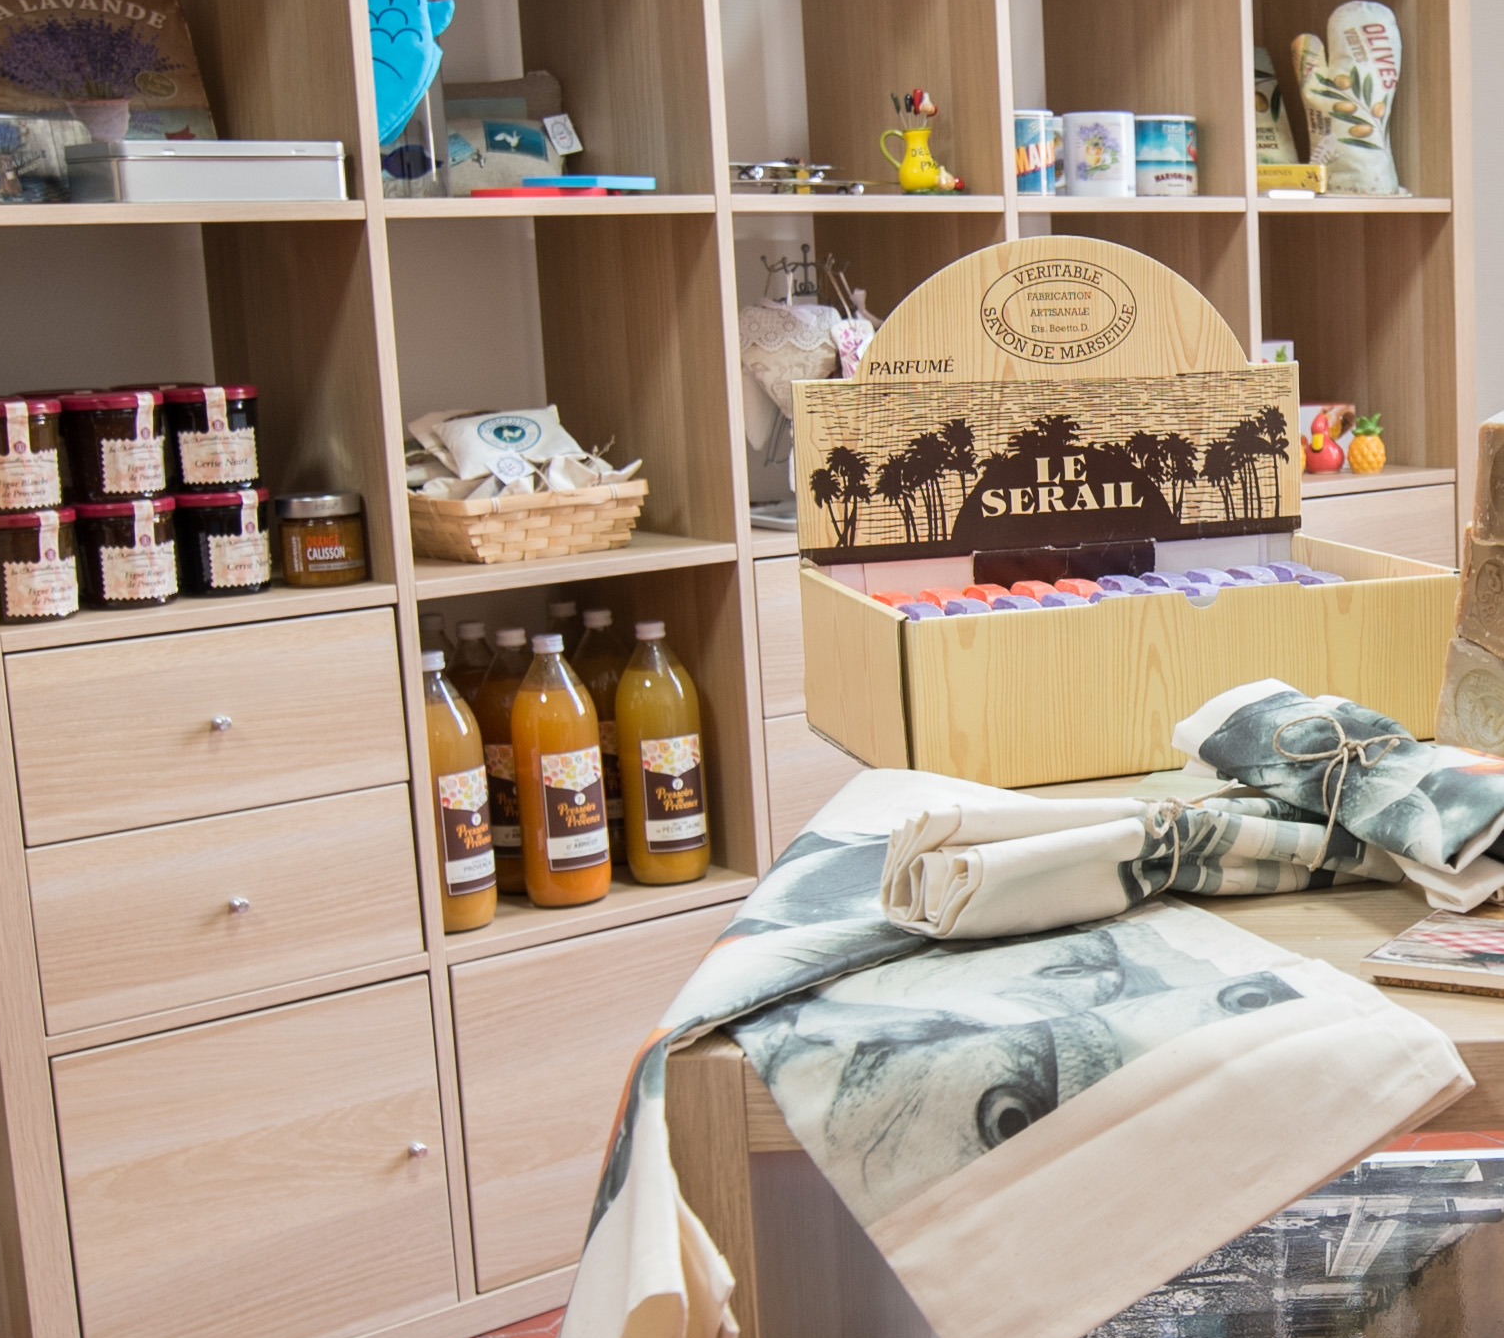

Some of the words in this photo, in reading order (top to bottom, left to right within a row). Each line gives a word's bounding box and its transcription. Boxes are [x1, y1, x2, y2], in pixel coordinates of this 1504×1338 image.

[1362, 22, 1398, 91] OLIVES
[1013, 264, 1103, 286] VERITABLE
[1027, 291, 1092, 301] FABRICATION
[1030, 307, 1090, 317] ARTISANALE
[983, 307, 1027, 353] SAVON
[1031, 343, 1055, 360] DE
[1060, 304, 1136, 360] MARSEILLE
[869, 355, 955, 377] PARFUMÉ
[1036, 453, 1088, 485] LE
[981, 477, 1144, 518] SERAIL
[306, 545, 346, 561] CALISSON
